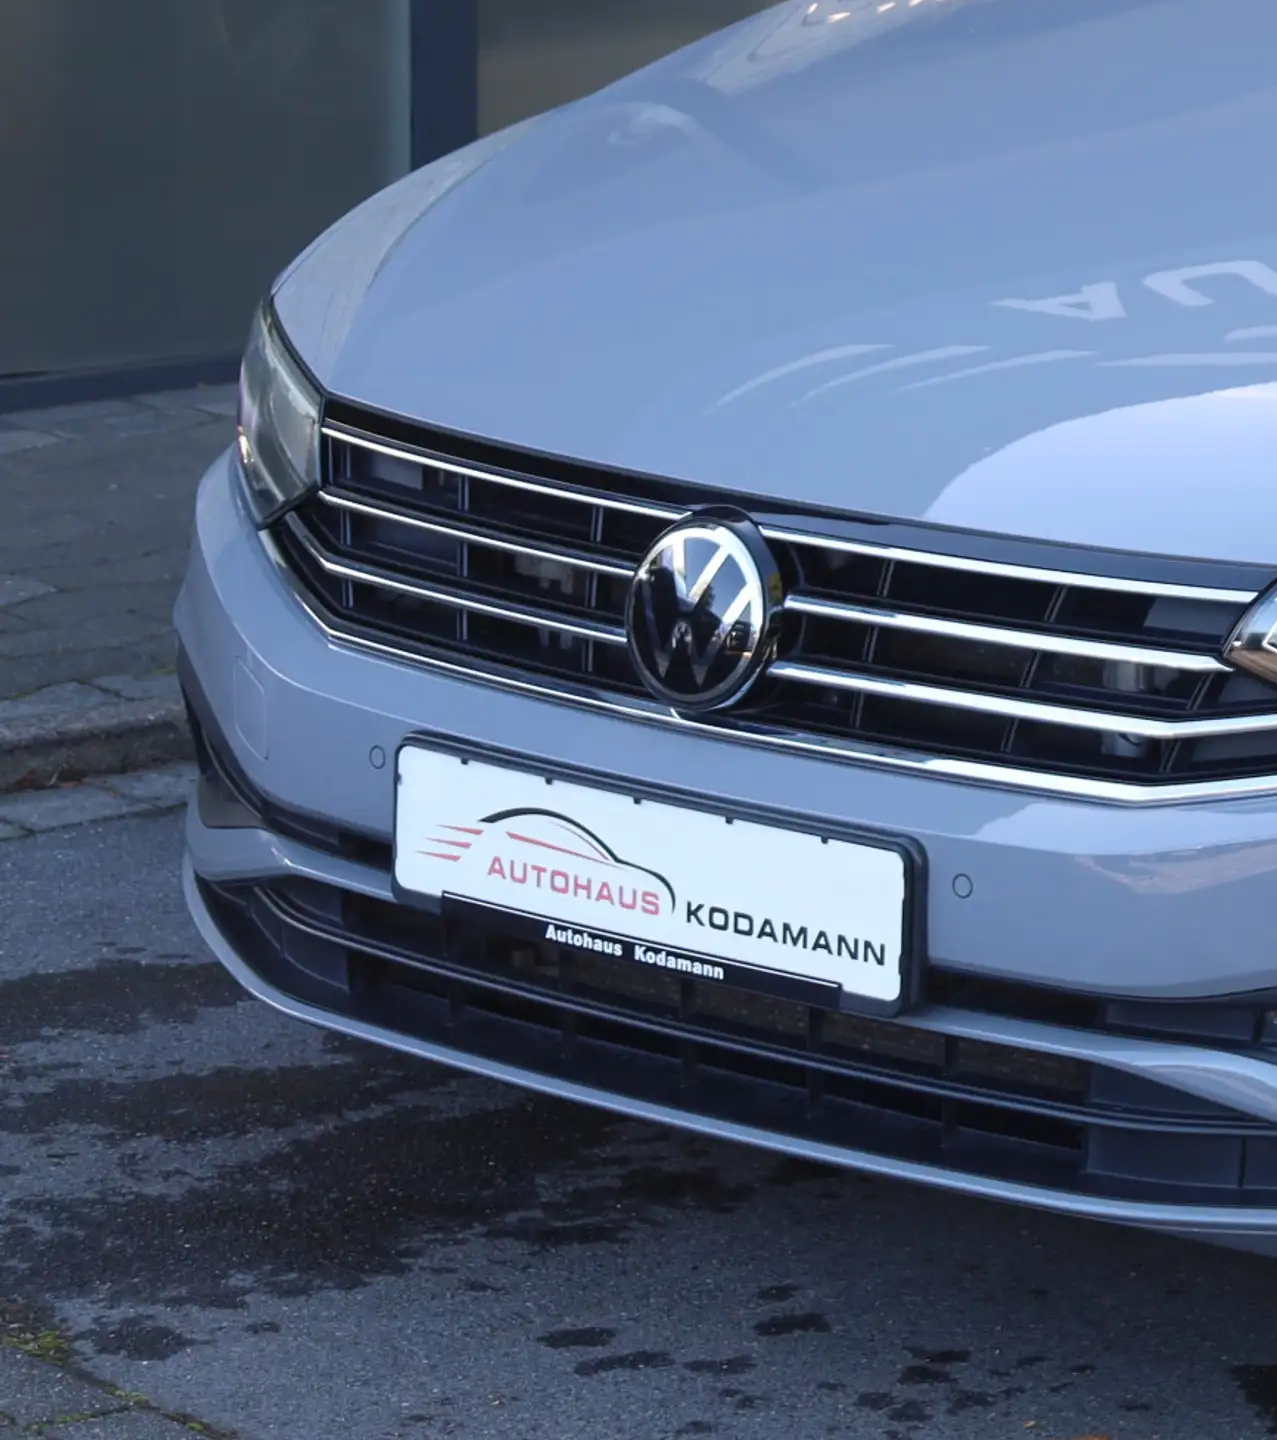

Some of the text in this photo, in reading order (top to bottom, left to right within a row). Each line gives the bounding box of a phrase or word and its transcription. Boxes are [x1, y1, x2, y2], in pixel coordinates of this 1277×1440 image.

[486, 856, 887, 967] AUTOHAUS KODAMANN
[544, 924, 725, 981] Autohaus Kodamann
